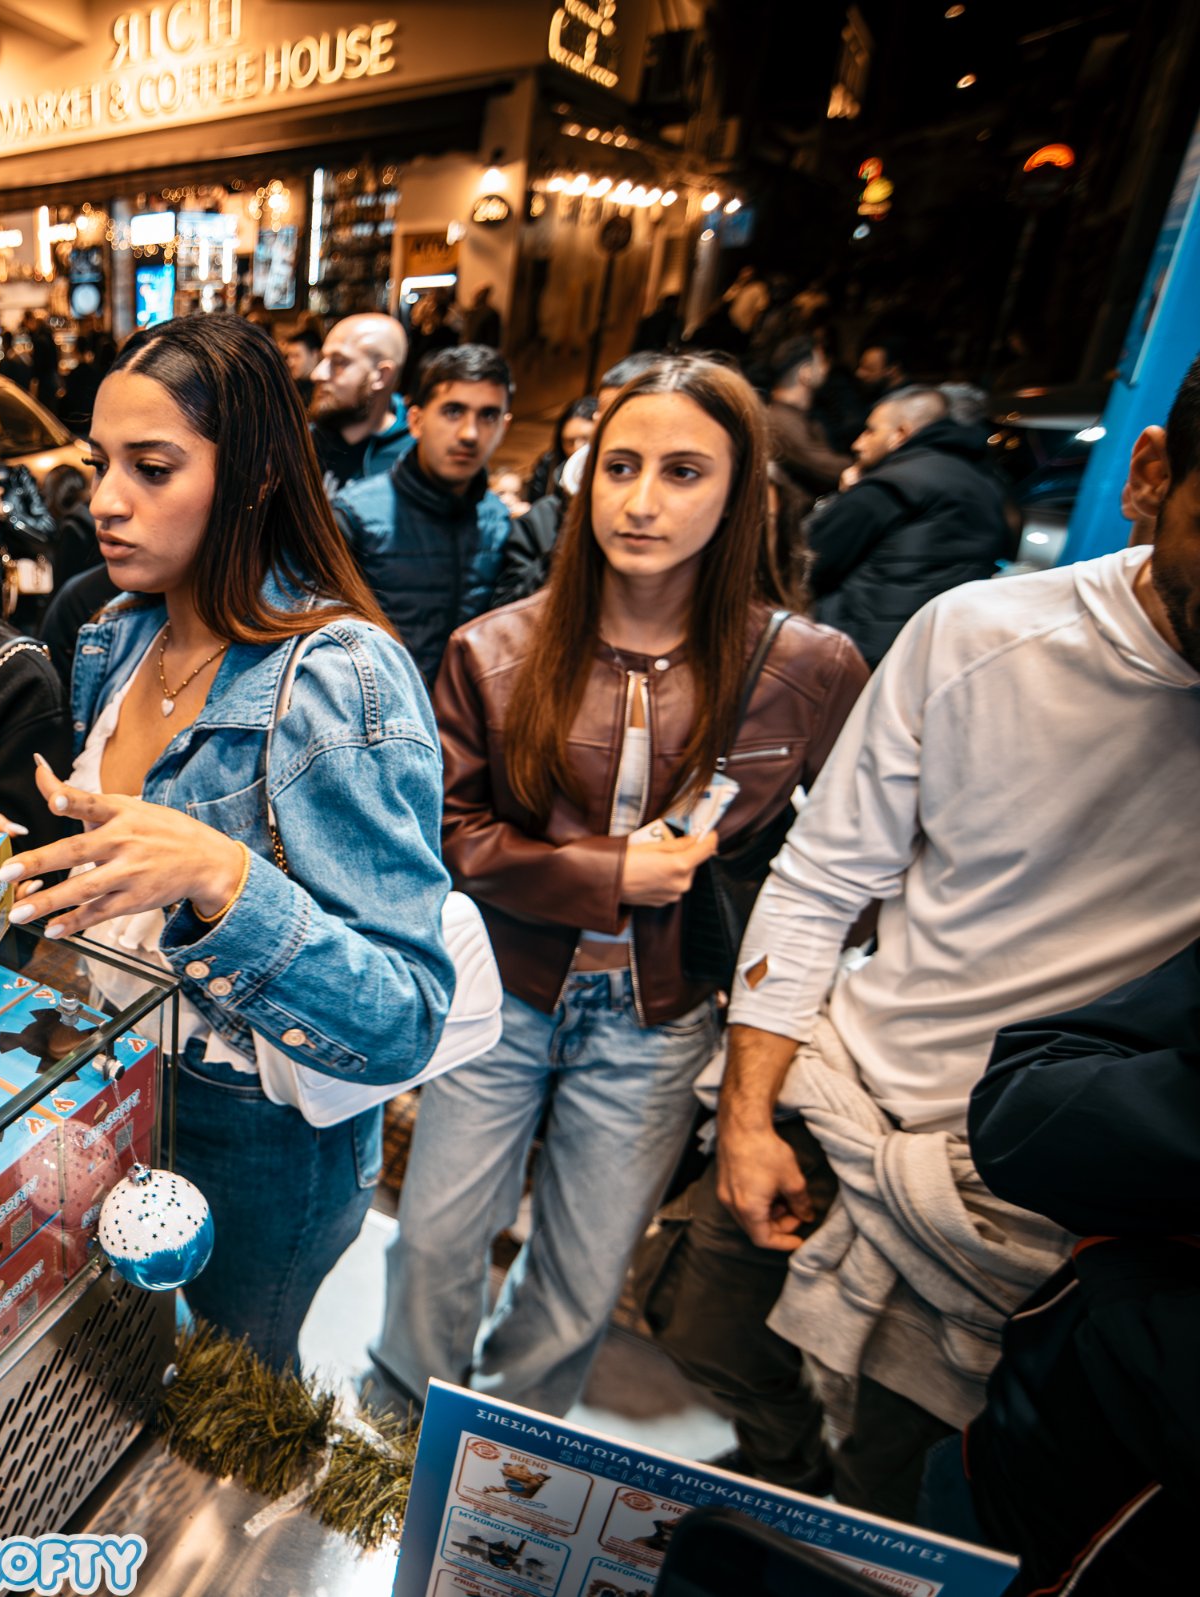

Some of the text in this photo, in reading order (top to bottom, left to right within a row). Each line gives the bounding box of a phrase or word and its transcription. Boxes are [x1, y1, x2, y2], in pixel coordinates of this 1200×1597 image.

[109, 78, 131, 120] &
[139, 53, 258, 117] COFFEE
[263, 19, 397, 93] HOUSE
[476, 1408, 551, 1441] ΣΠΕΣΙΑΛ
[556, 1434, 632, 1467] ΠΑΓΩΤΑ
[671, 1473, 831, 1529] ΑΠΟΚΛΕΙΣΤΙΚΕΣ
[836, 1522, 947, 1564] ΣΥΝΤΑΓΕΣ
[509, 1452, 548, 1472] BUENO
[557, 1449, 659, 1492] SPECIAL
[670, 1485, 712, 1508] ICE
[453, 1576, 481, 1590] PRIDE
